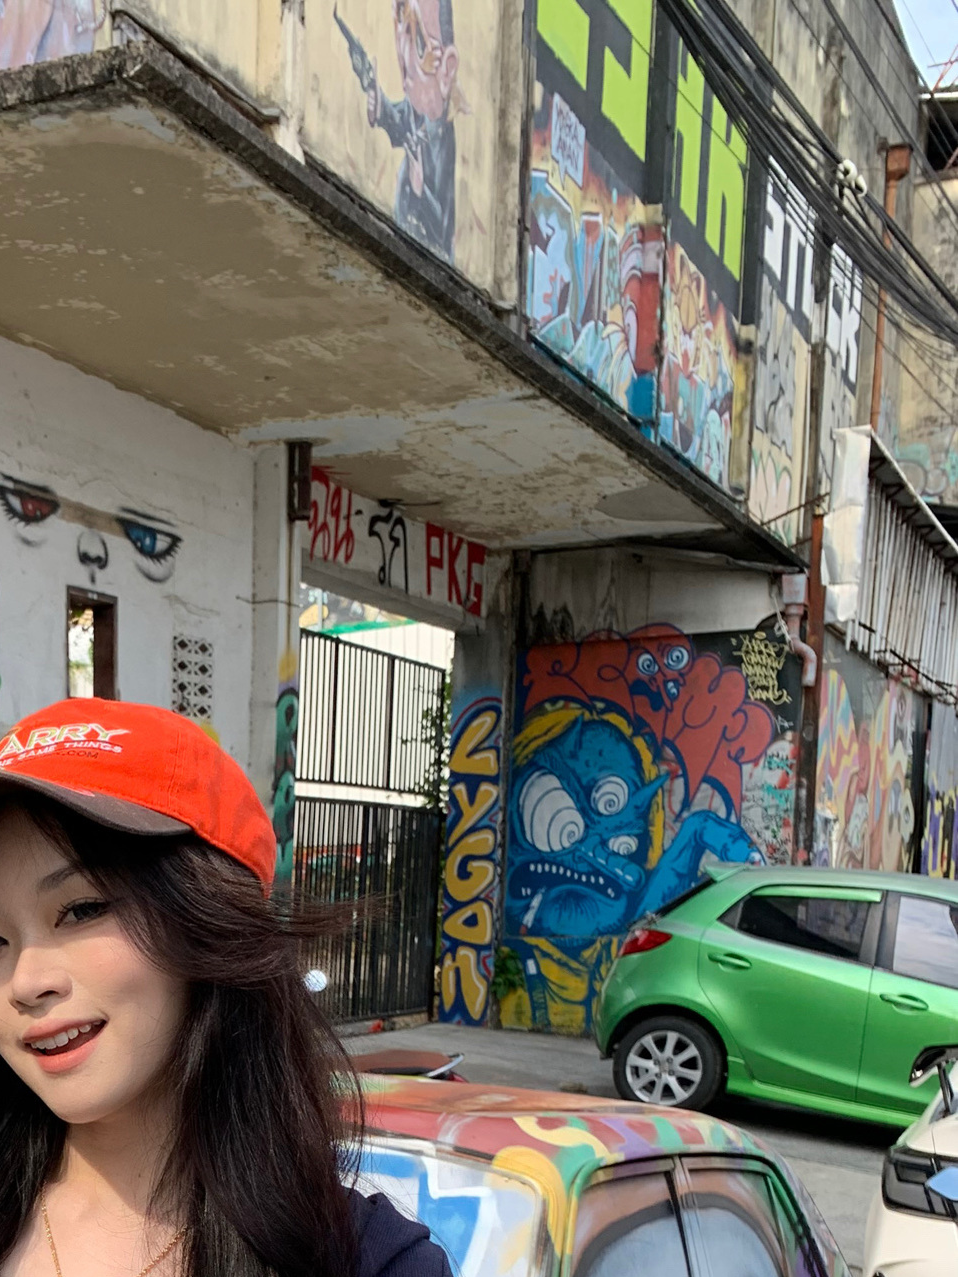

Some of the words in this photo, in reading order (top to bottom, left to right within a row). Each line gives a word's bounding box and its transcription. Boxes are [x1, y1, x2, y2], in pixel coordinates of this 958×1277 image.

[426, 521, 487, 617] PKG
[17, 745, 58, 760] SAME
[64, 742, 123, 754] THINGS
